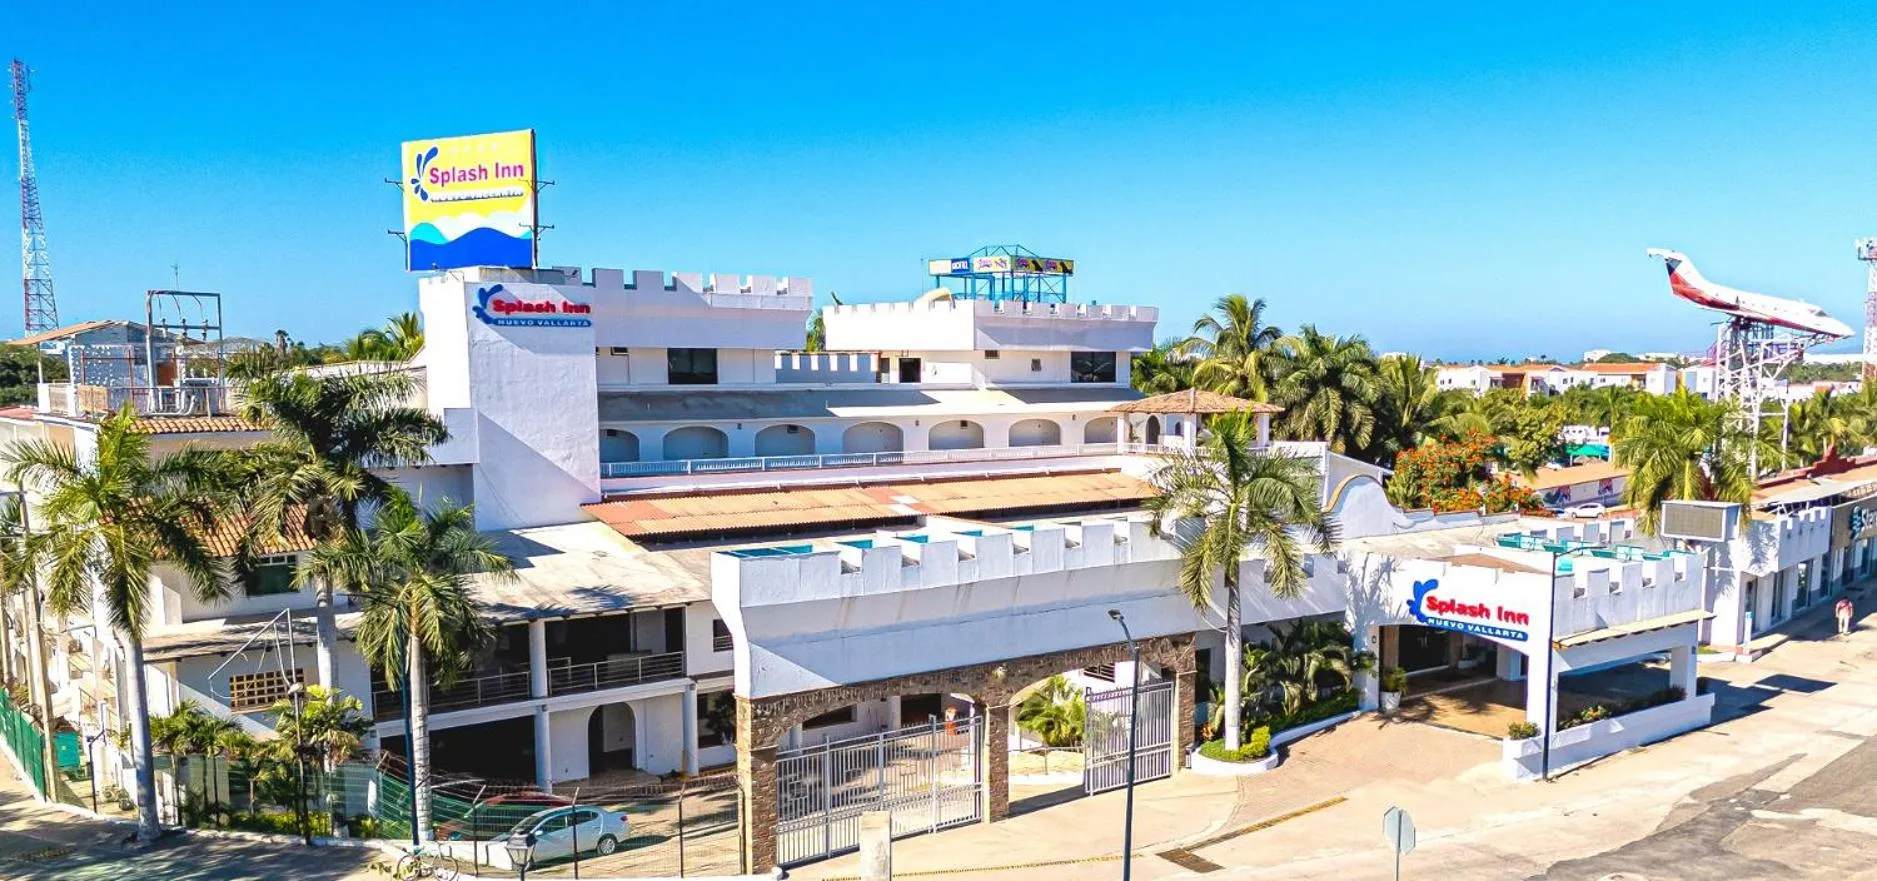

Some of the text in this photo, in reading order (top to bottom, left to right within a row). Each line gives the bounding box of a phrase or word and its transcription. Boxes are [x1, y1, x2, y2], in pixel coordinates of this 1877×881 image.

[429, 162, 524, 187] Splash Inn
[493, 299, 591, 315] Splash Inn
[537, 319, 589, 327] VALLARTA
[1426, 595, 1529, 626] Splash Inn
[1428, 618, 1524, 640] NUEVO VALLARTA
